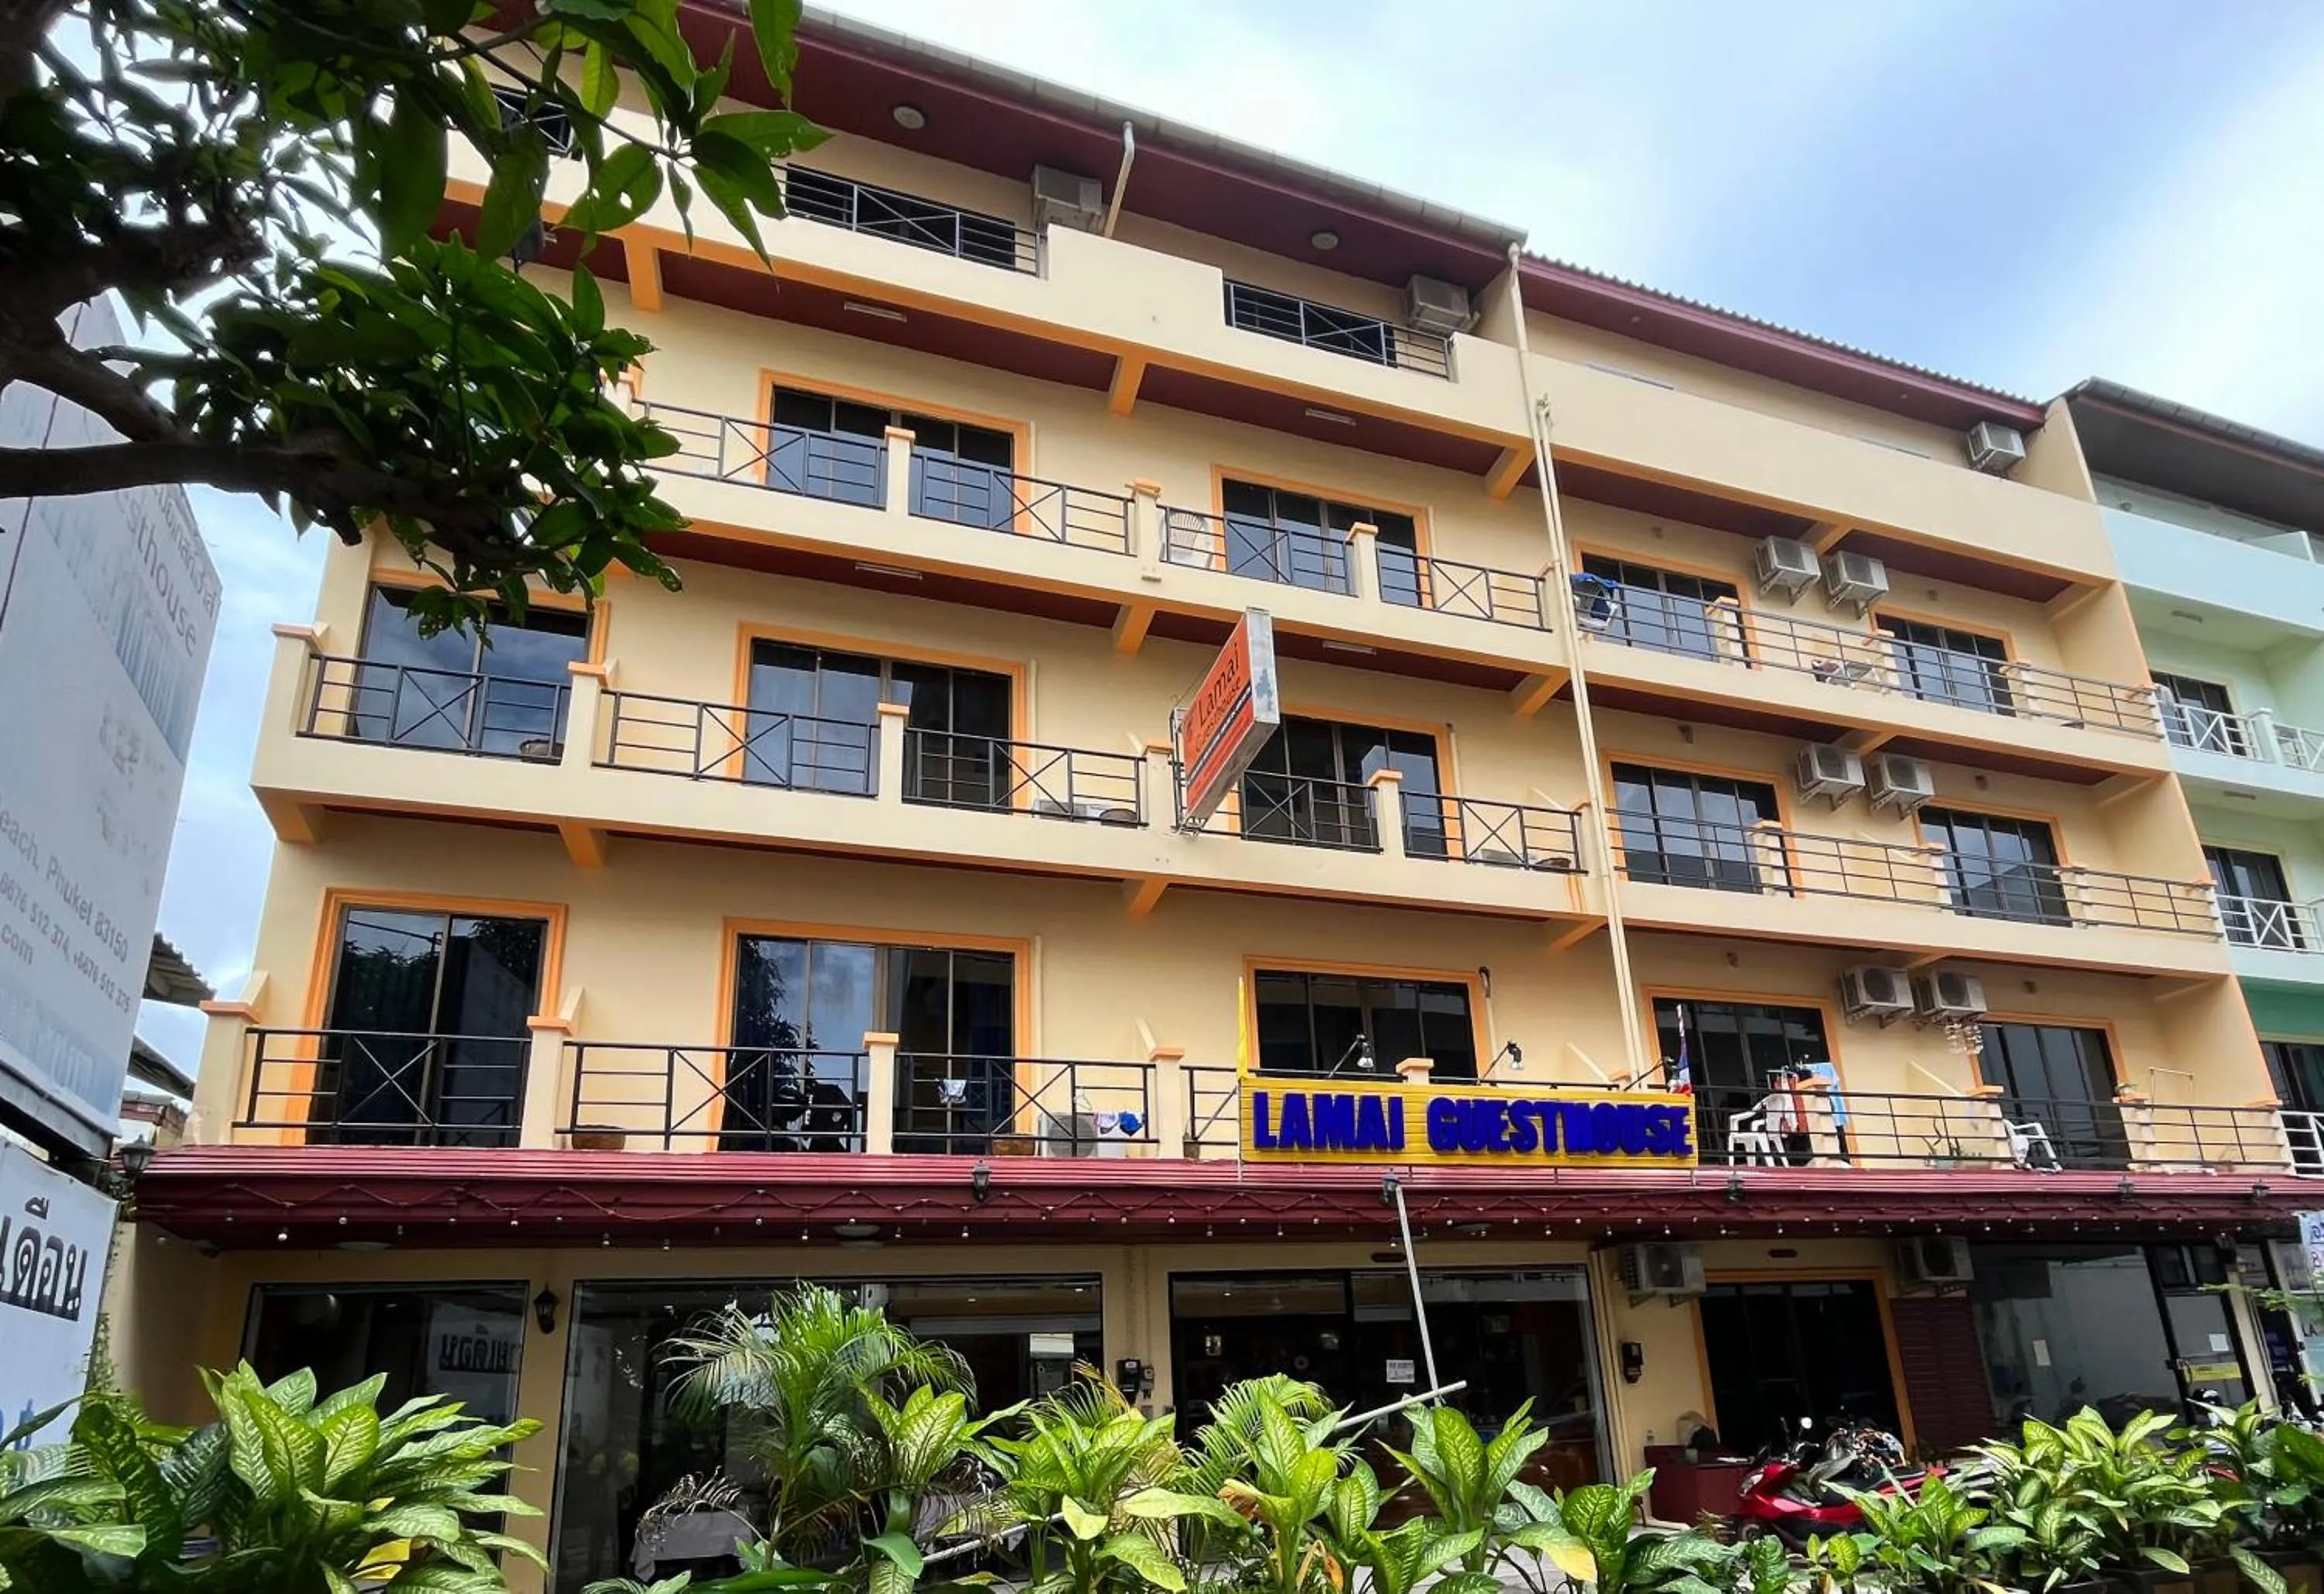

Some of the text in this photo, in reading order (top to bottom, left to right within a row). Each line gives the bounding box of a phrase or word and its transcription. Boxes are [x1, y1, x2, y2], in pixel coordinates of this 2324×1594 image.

[1198, 643, 1239, 727] Lamai
[29, 902, 50, 936] 512
[99, 972, 115, 1001] 512
[46, 854, 94, 926] Phuket
[95, 911, 128, 963] 83150
[1253, 1091, 1694, 1157] LAMAI GUESTHOUSE
